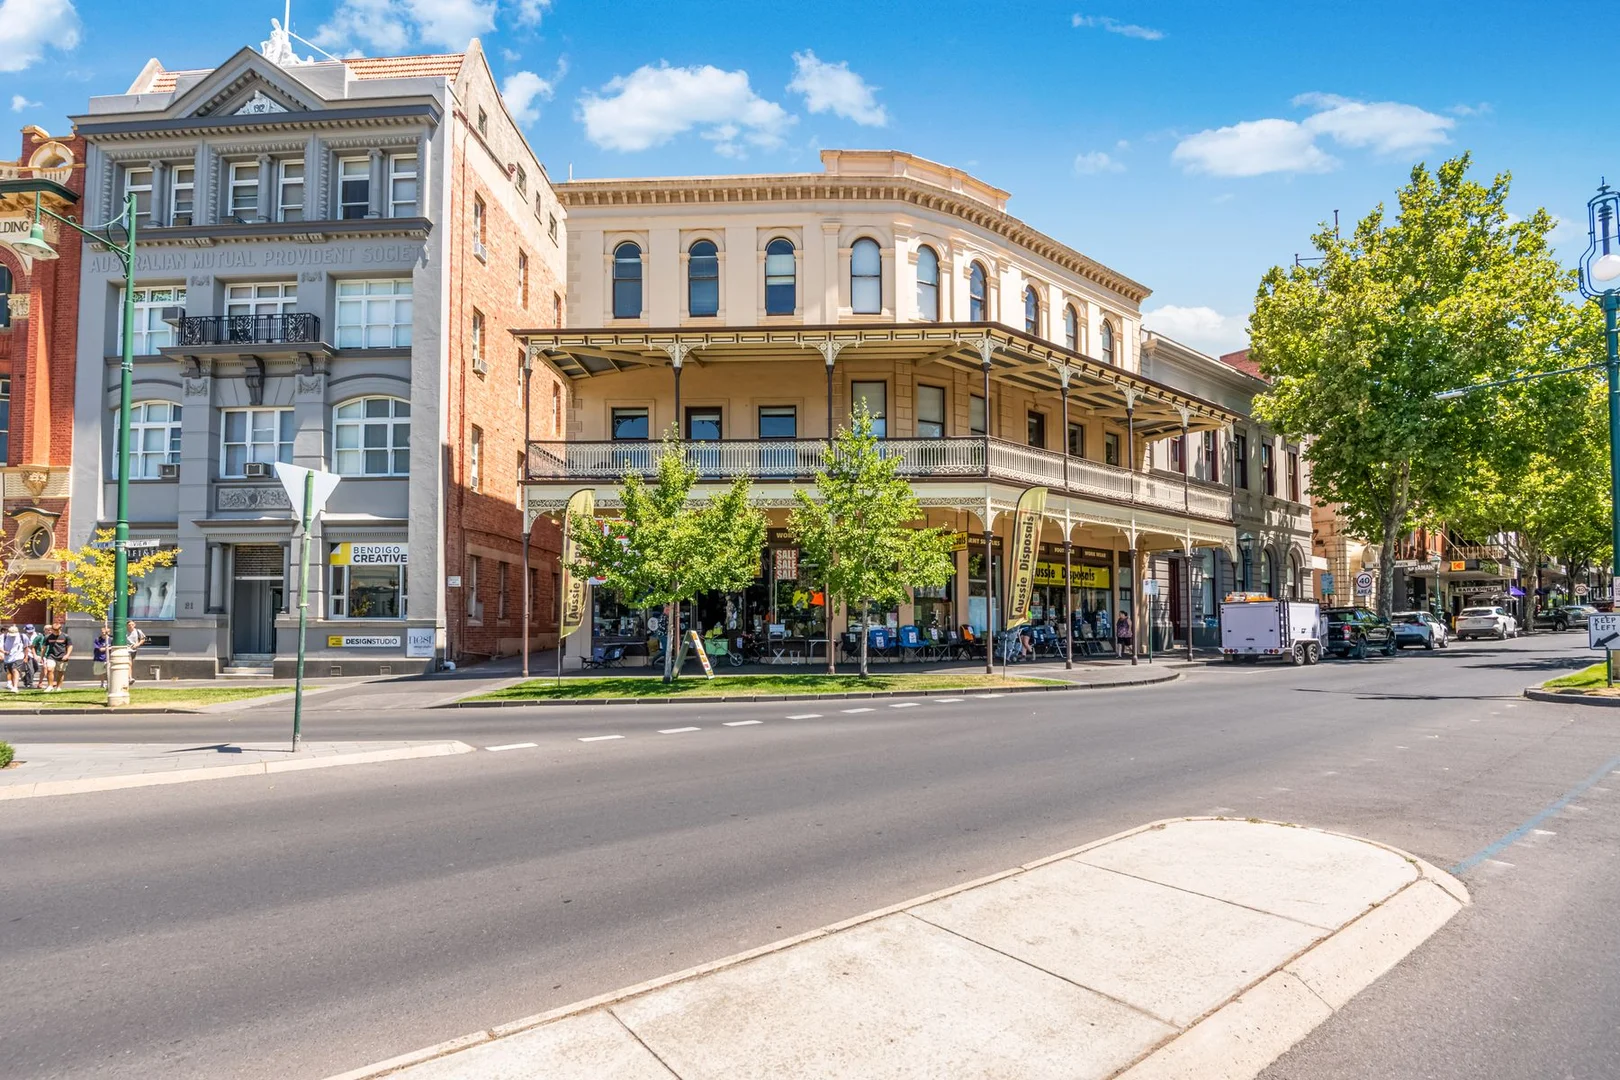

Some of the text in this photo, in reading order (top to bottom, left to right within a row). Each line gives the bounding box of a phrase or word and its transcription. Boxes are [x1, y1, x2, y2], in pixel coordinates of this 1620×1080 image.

[89, 245, 424, 273] AUSRALIAN MUTUAL PROVIDENT SOCIET
[1019, 516, 1034, 571] Disposals
[353, 546, 401, 554] BENDIGO
[776, 549, 797, 559] SALE
[353, 554, 408, 563] CREATIVE
[776, 559, 797, 569] SALE
[776, 569, 797, 579] SALE
[1035, 565, 1095, 583] ussie Dsposals
[1359, 577, 1370, 585] 40
[1015, 576, 1028, 613] Aussie
[185, 601, 194, 610] 21
[568, 582, 581, 620] Aussie
